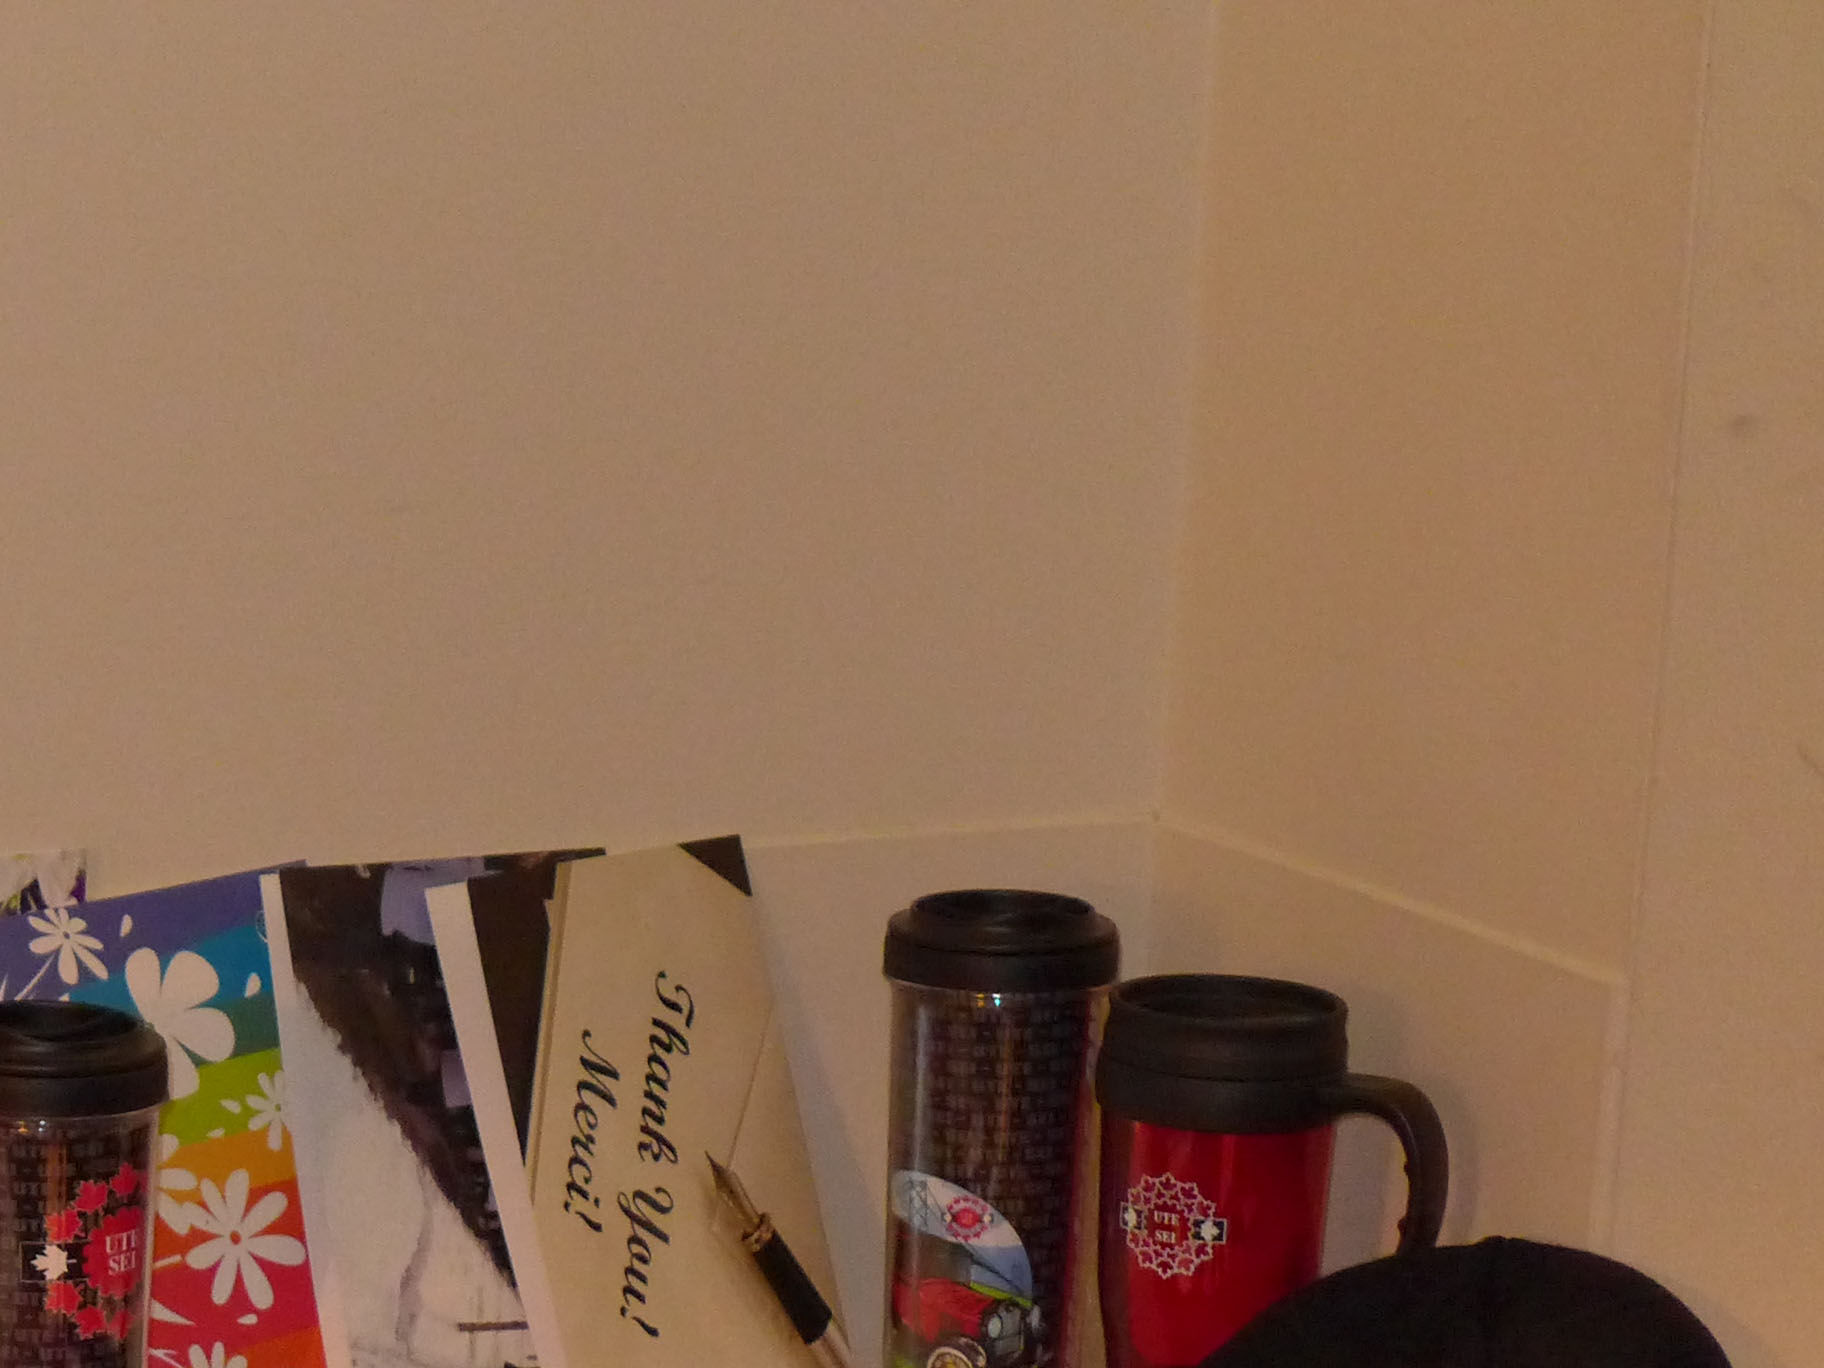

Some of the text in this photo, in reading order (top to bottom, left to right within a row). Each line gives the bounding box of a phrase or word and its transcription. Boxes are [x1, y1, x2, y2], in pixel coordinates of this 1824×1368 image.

[563, 1029, 621, 1234] Merci!
[617, 970, 694, 1338] Thank You!
[1154, 1211, 1179, 1226] UTE
[1155, 1230, 1176, 1243] SEI
[108, 1251, 136, 1275] SEI
